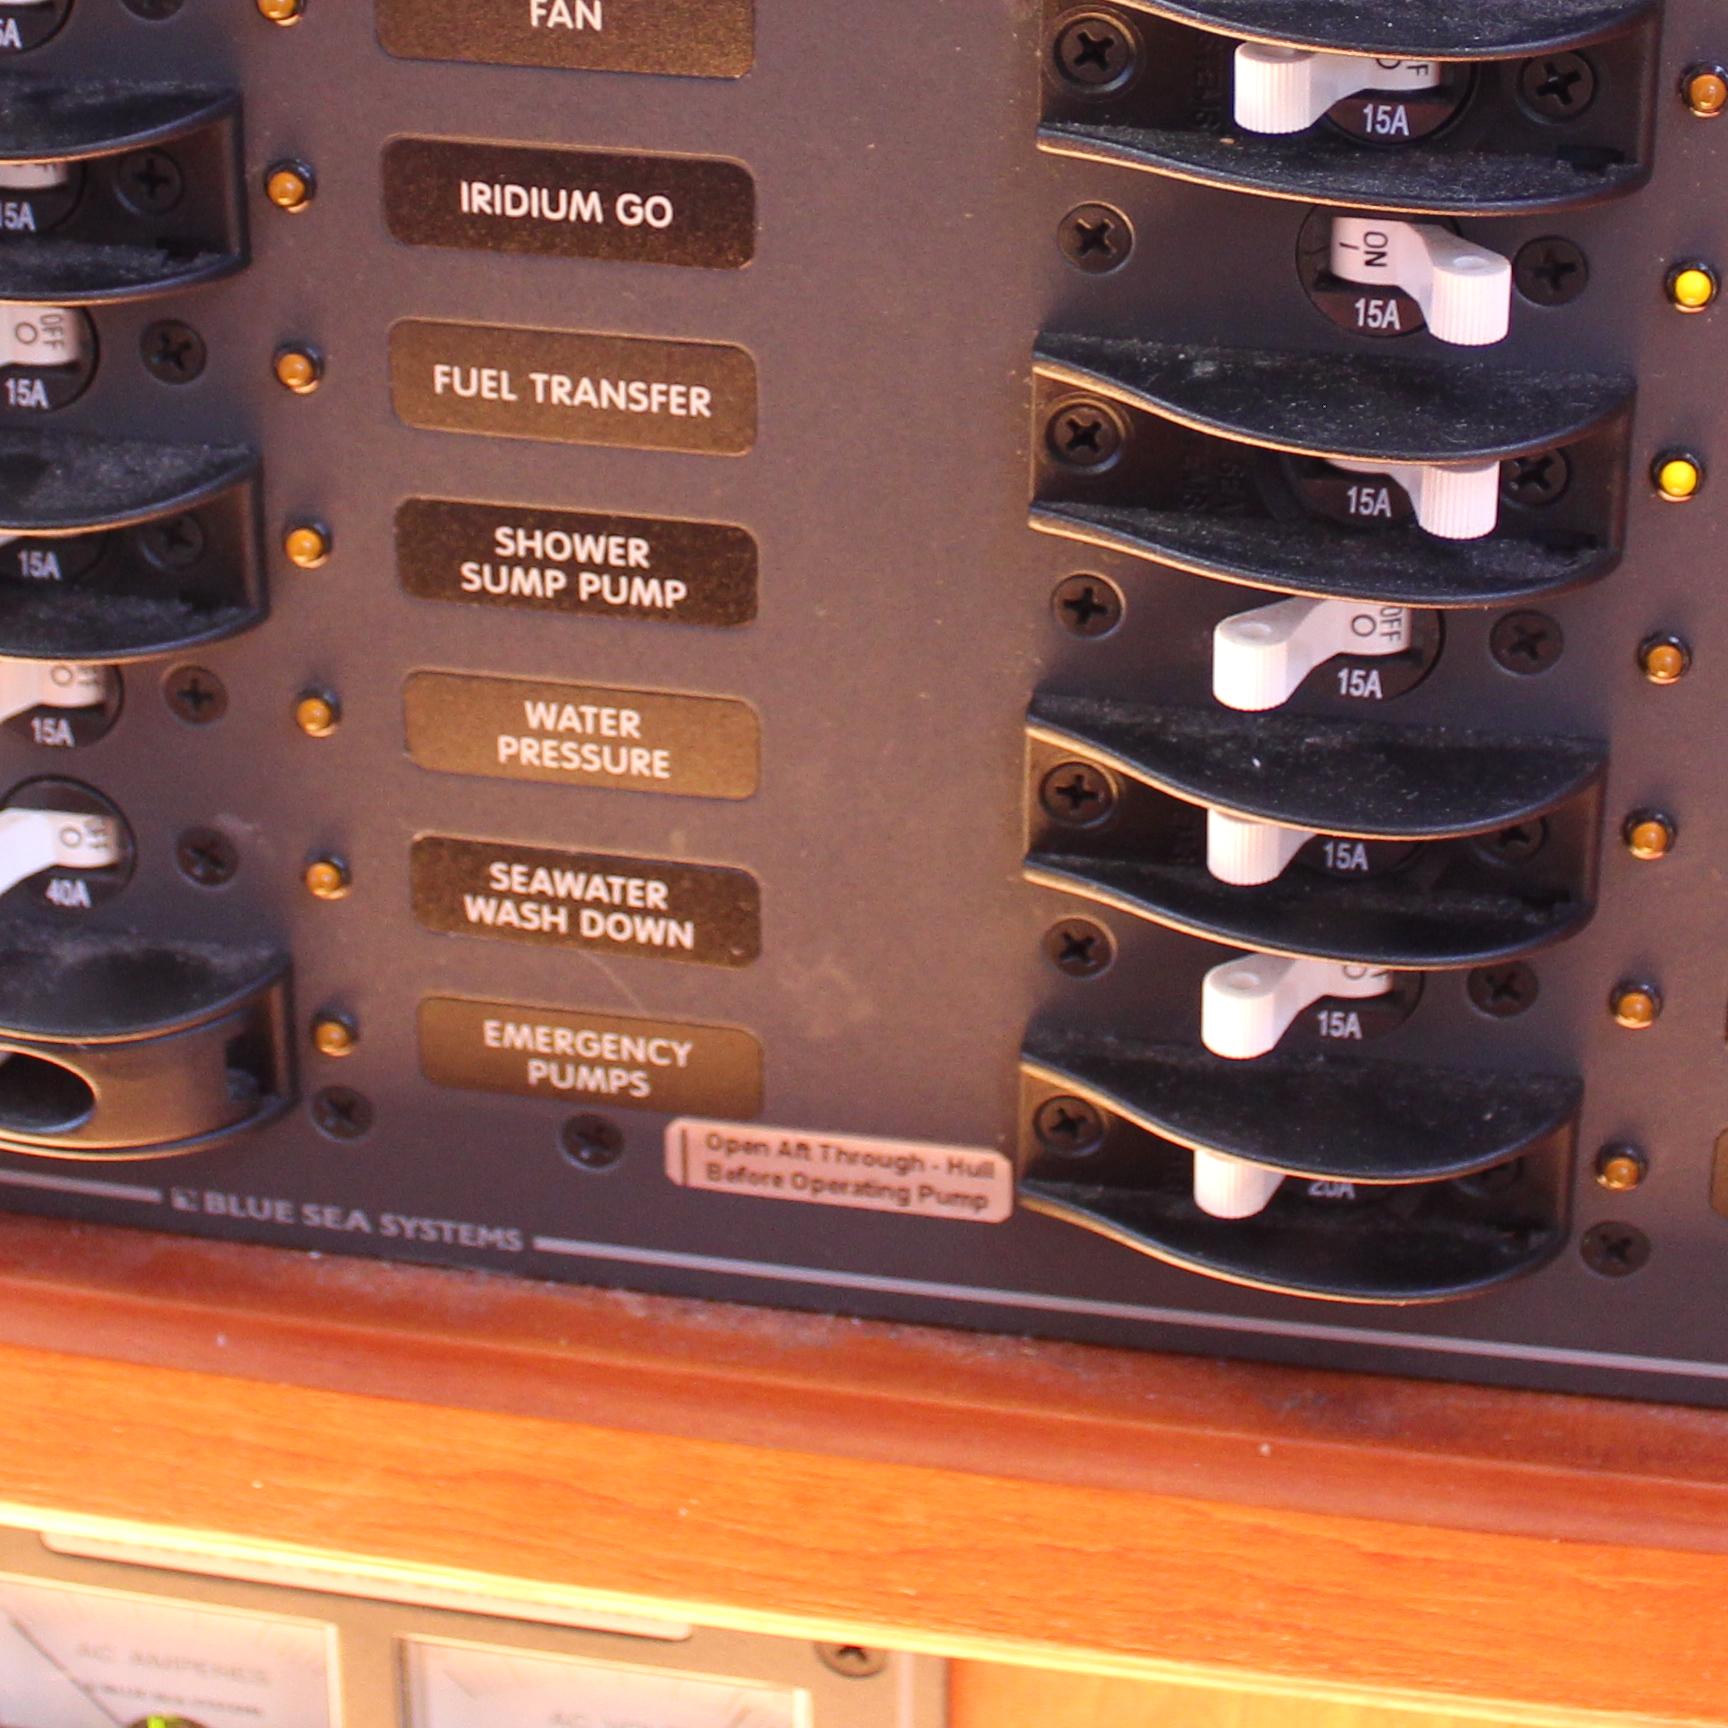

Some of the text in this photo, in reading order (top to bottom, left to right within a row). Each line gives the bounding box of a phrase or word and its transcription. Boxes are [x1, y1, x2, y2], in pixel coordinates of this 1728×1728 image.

[1363, 103, 1410, 136] 15A
[460, 181, 673, 228] IRIDIUM GO
[1363, 231, 1388, 268] ON
[40, 314, 65, 351] OFF
[1355, 298, 1401, 331] 15A
[5, 378, 49, 409] 15A
[434, 364, 711, 418] FUEL TRANSFER
[1347, 486, 1392, 518] 15A
[19, 551, 61, 579] 15A
[494, 526, 650, 569] SHOWER
[460, 561, 687, 609] SUMP PUMP
[1379, 607, 1402, 641] OFF
[1338, 668, 1383, 699] 15A
[31, 717, 74, 746] 15A
[524, 700, 641, 739] WATER
[497, 735, 670, 779] PRESSURE
[1324, 842, 1368, 871] 15A
[46, 879, 90, 907] 40A
[489, 862, 668, 910] SEAWATER
[464, 895, 694, 949] WASH DOWN
[483, 1019, 693, 1067] EMERGENCY
[1317, 1010, 1362, 1039] 15A
[527, 1058, 651, 1098] PUMPS
[705, 1132, 768, 1156] Open
[778, 1141, 810, 1161] Aft
[819, 1144, 924, 1175] Through
[948, 1157, 995, 1179] Hull
[707, 1163, 989, 1212] Before Operating Pump
[204, 1191, 523, 1252] BLUE SEA SYSTEMS
